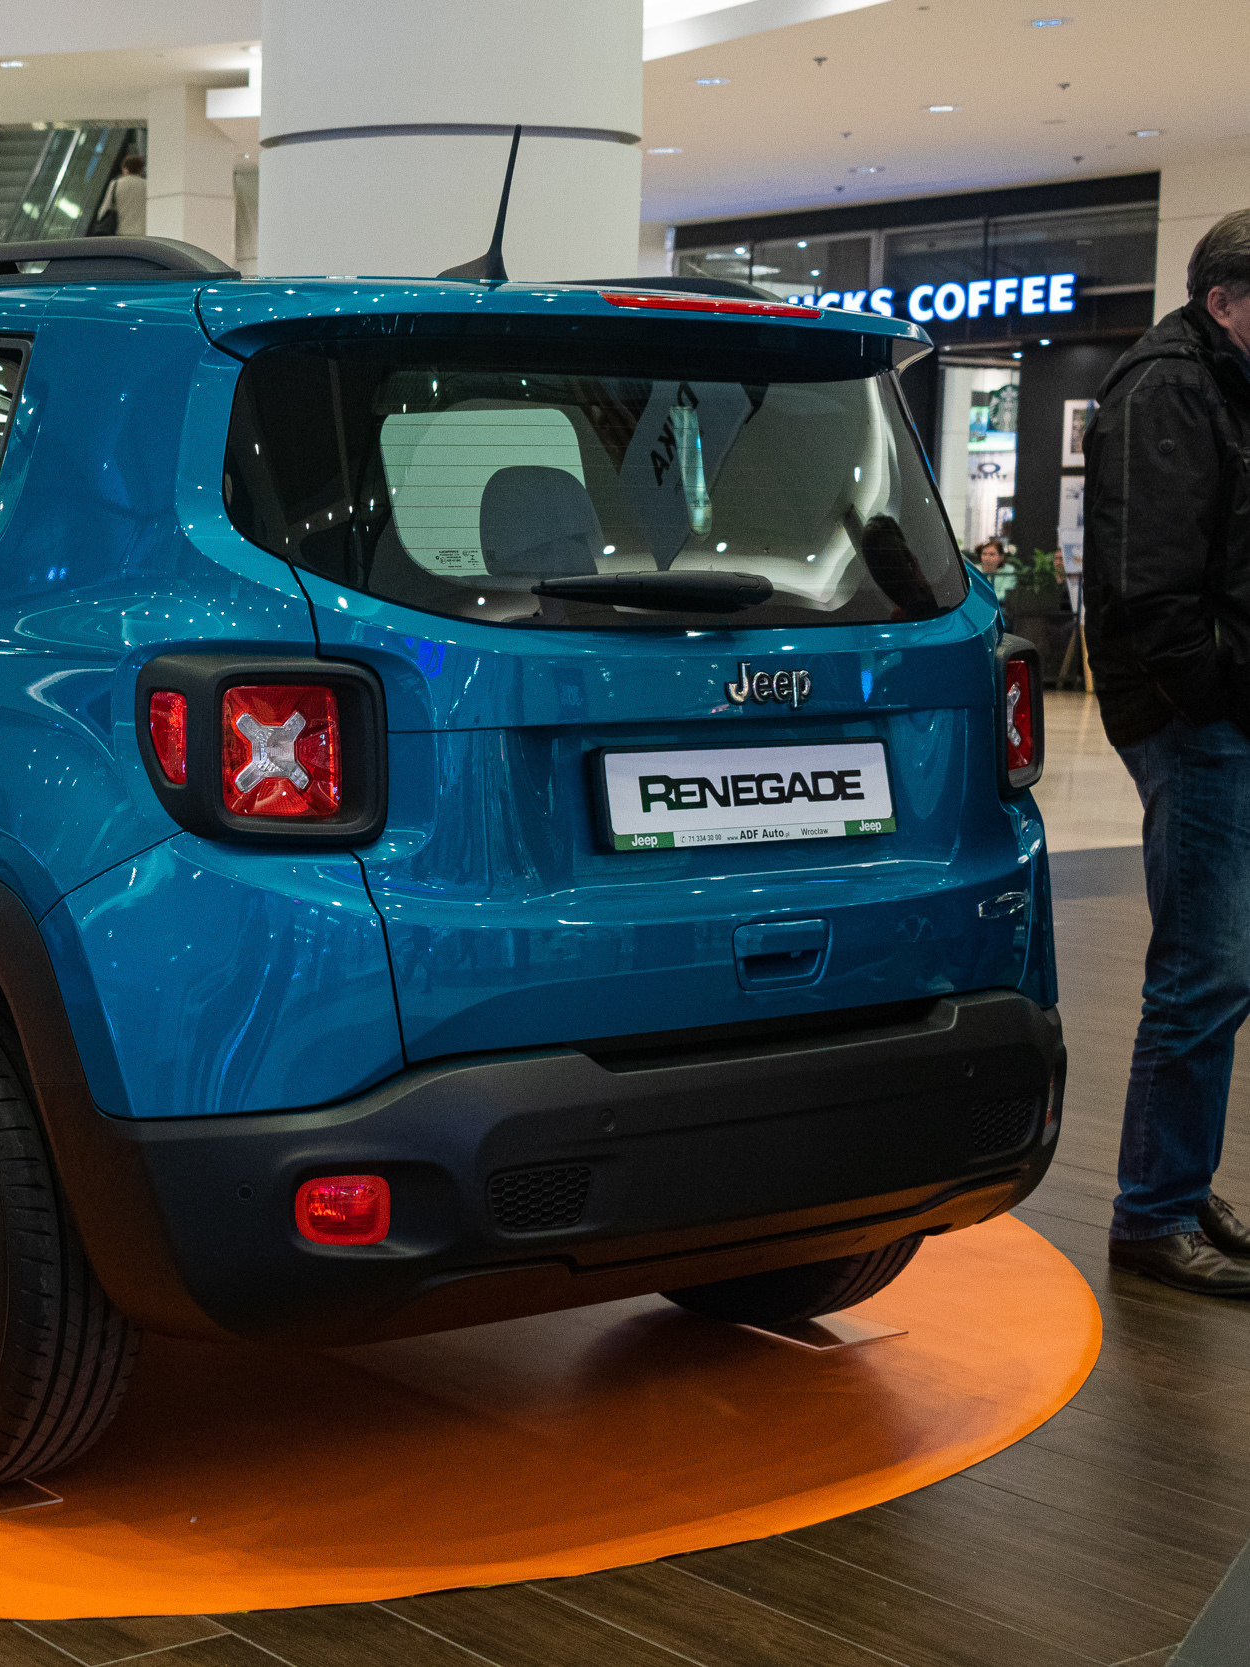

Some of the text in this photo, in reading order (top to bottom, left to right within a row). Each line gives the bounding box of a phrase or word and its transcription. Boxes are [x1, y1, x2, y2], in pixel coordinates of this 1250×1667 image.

[907, 272, 1076, 322] COFFEE
[725, 660, 812, 709] Jeep
[639, 769, 865, 813] RENEGADE
[631, 834, 658, 848] Jeep
[696, 834, 706, 842] 334
[859, 820, 882, 833] Jeep
